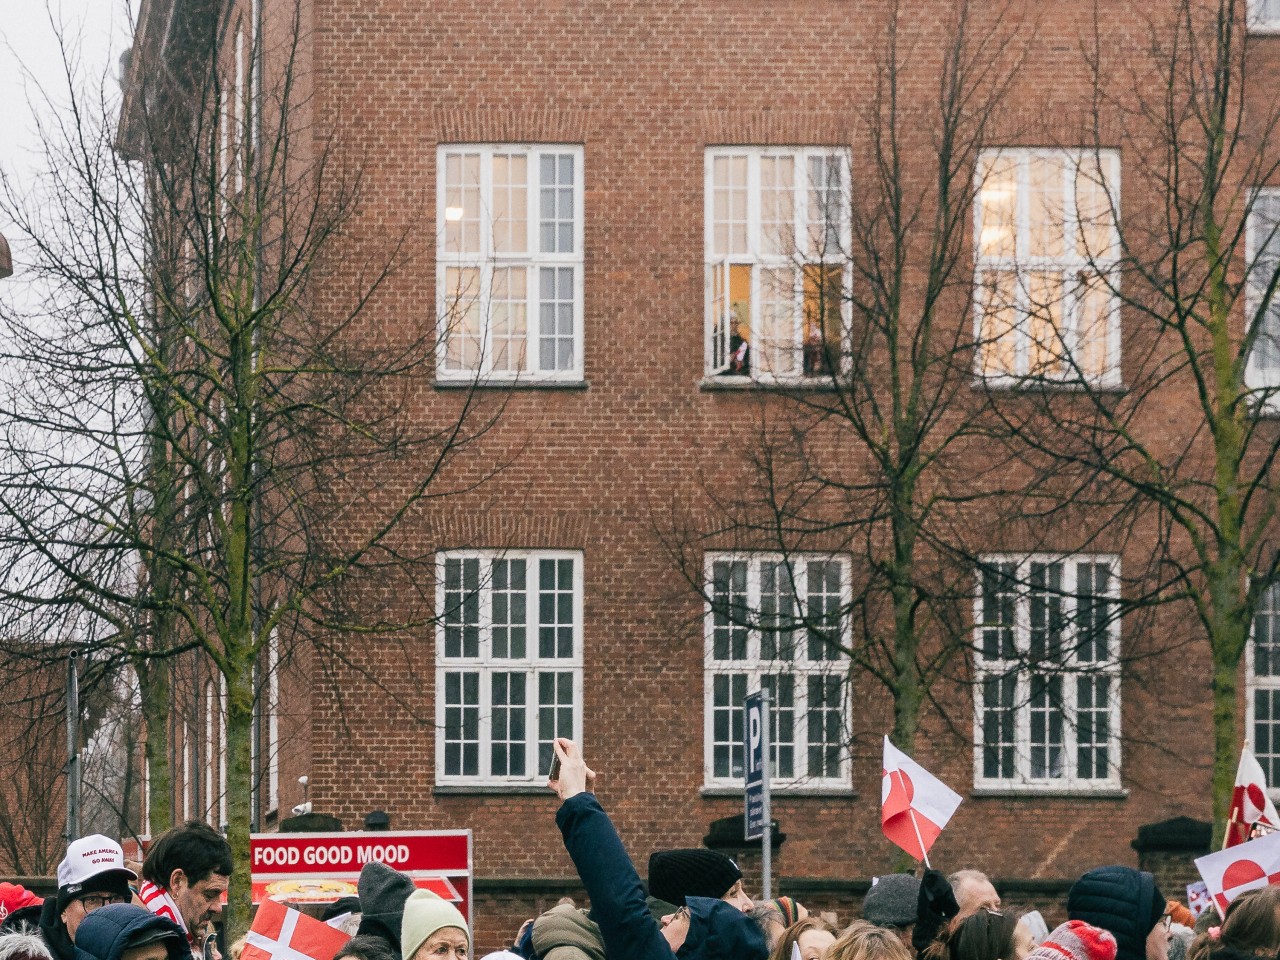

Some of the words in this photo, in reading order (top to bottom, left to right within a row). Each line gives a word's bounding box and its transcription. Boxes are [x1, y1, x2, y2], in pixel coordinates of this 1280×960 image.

[749, 706, 761, 773] P
[82, 849, 98, 858] MAKE
[254, 847, 300, 866] FOOD
[303, 846, 353, 865] GOOD
[357, 844, 410, 864] MOOD
